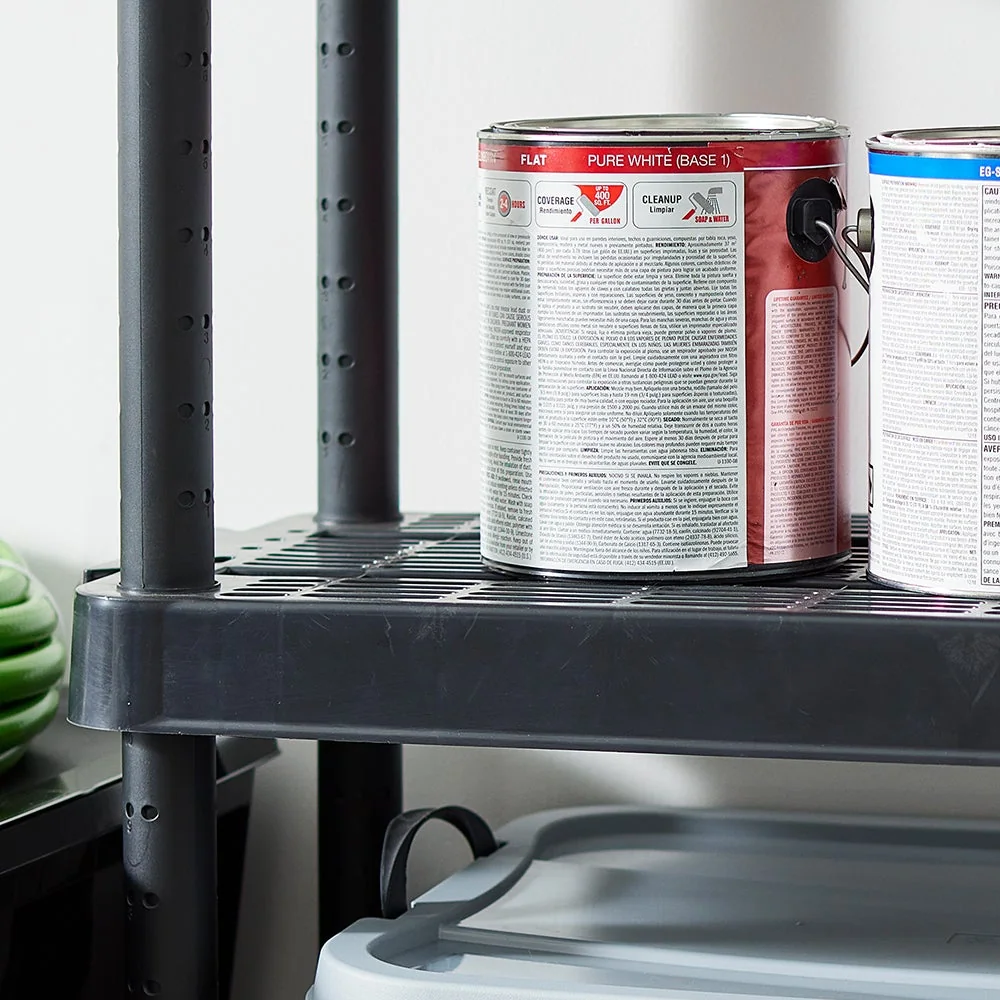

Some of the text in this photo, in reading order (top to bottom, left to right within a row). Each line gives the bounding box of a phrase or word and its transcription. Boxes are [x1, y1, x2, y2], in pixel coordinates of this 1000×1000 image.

[520, 154, 730, 168] FLAT PURE WHITE (BASE 1)
[500, 198, 508, 209] 24
[537, 196, 574, 206] COVERAGE
[642, 195, 682, 204] CLEANUP
